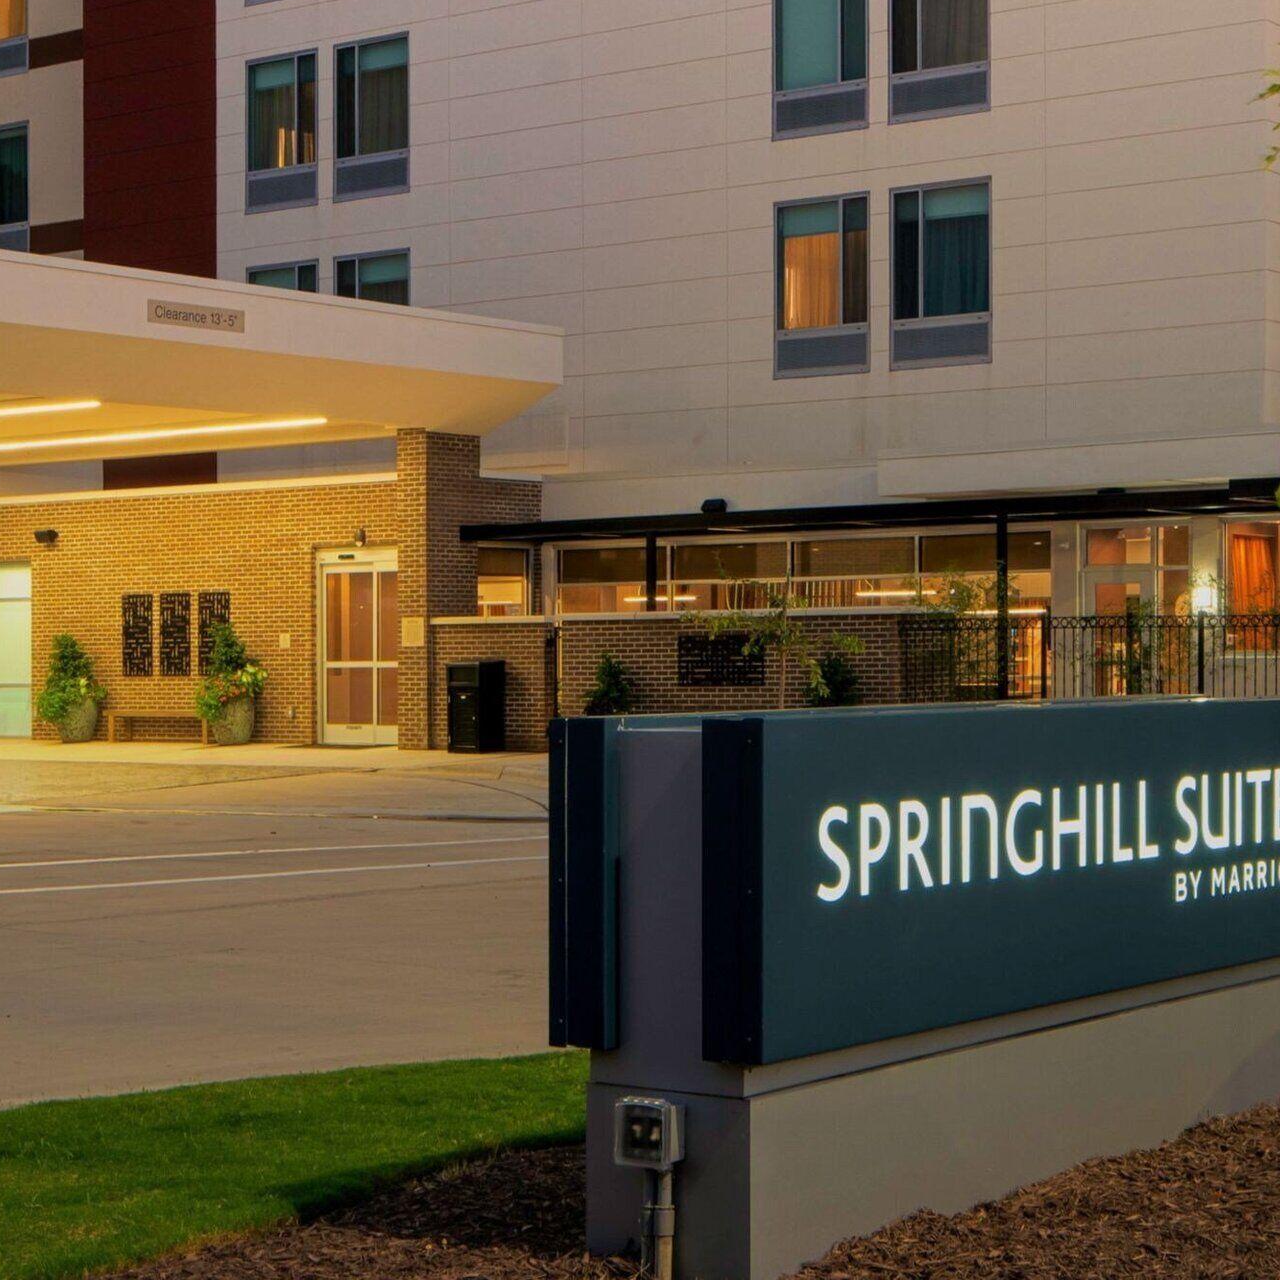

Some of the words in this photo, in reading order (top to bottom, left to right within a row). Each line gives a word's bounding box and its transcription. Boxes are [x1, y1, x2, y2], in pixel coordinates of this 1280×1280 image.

[154, 304, 207, 324] Clearance
[816, 778, 1160, 903] SPRINGHILL
[1174, 872, 1199, 903] BY
